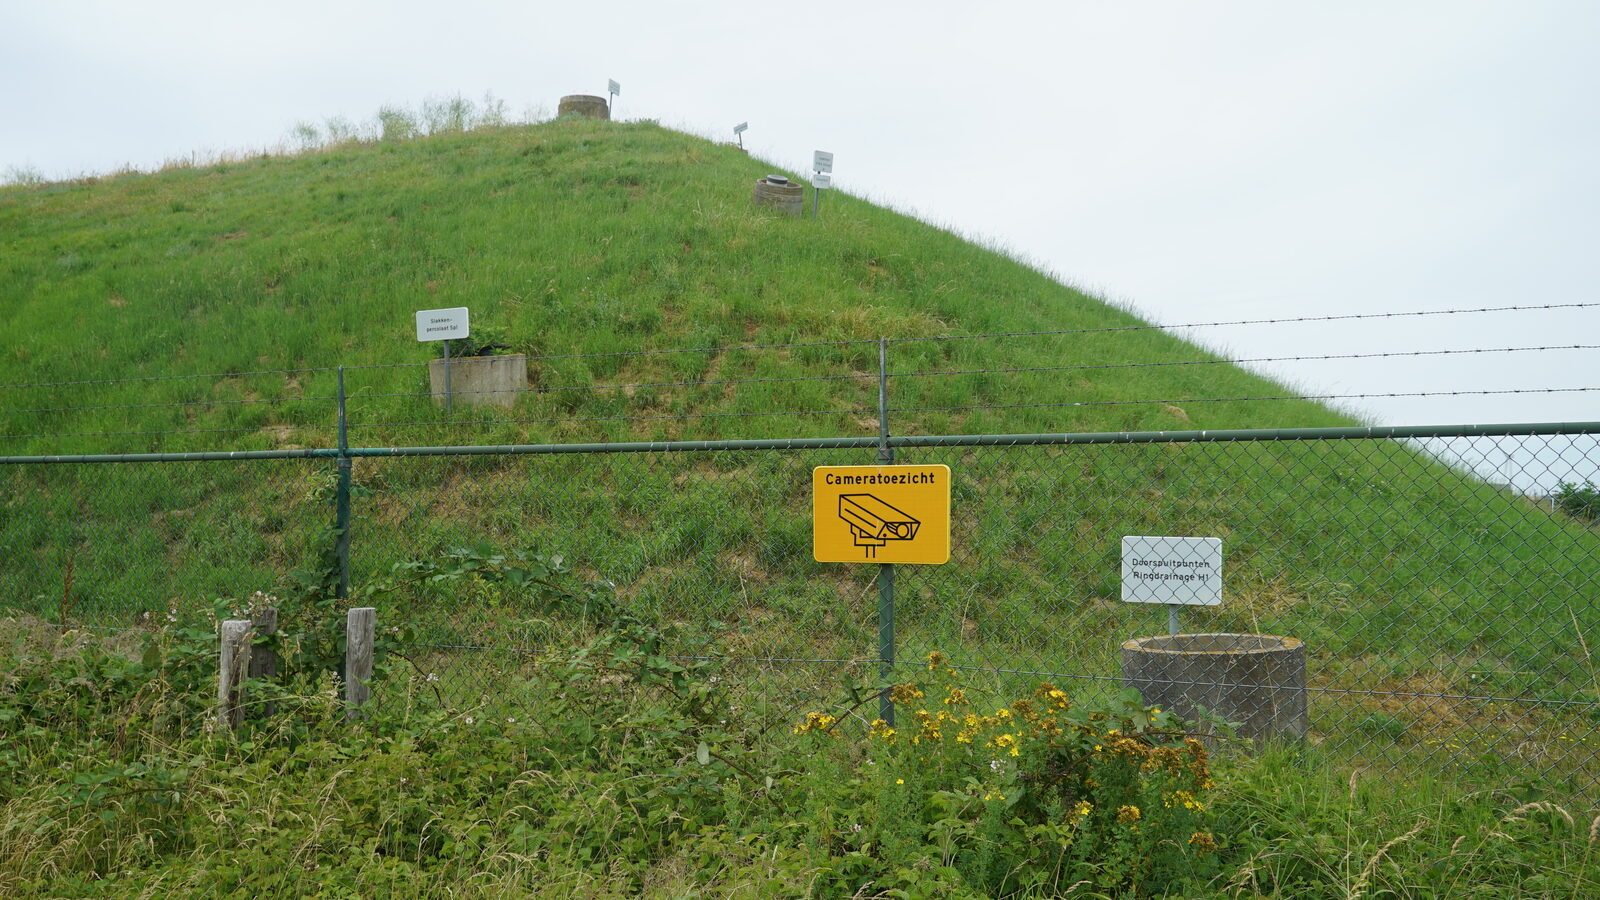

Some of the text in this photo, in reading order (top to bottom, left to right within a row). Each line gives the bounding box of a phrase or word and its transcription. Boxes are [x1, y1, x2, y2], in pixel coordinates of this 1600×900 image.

[825, 472, 935, 485] Cameratoezicht
[1132, 558, 1210, 568] Doorspuitpunten
[1133, 571, 1195, 583] Ringdrainage
